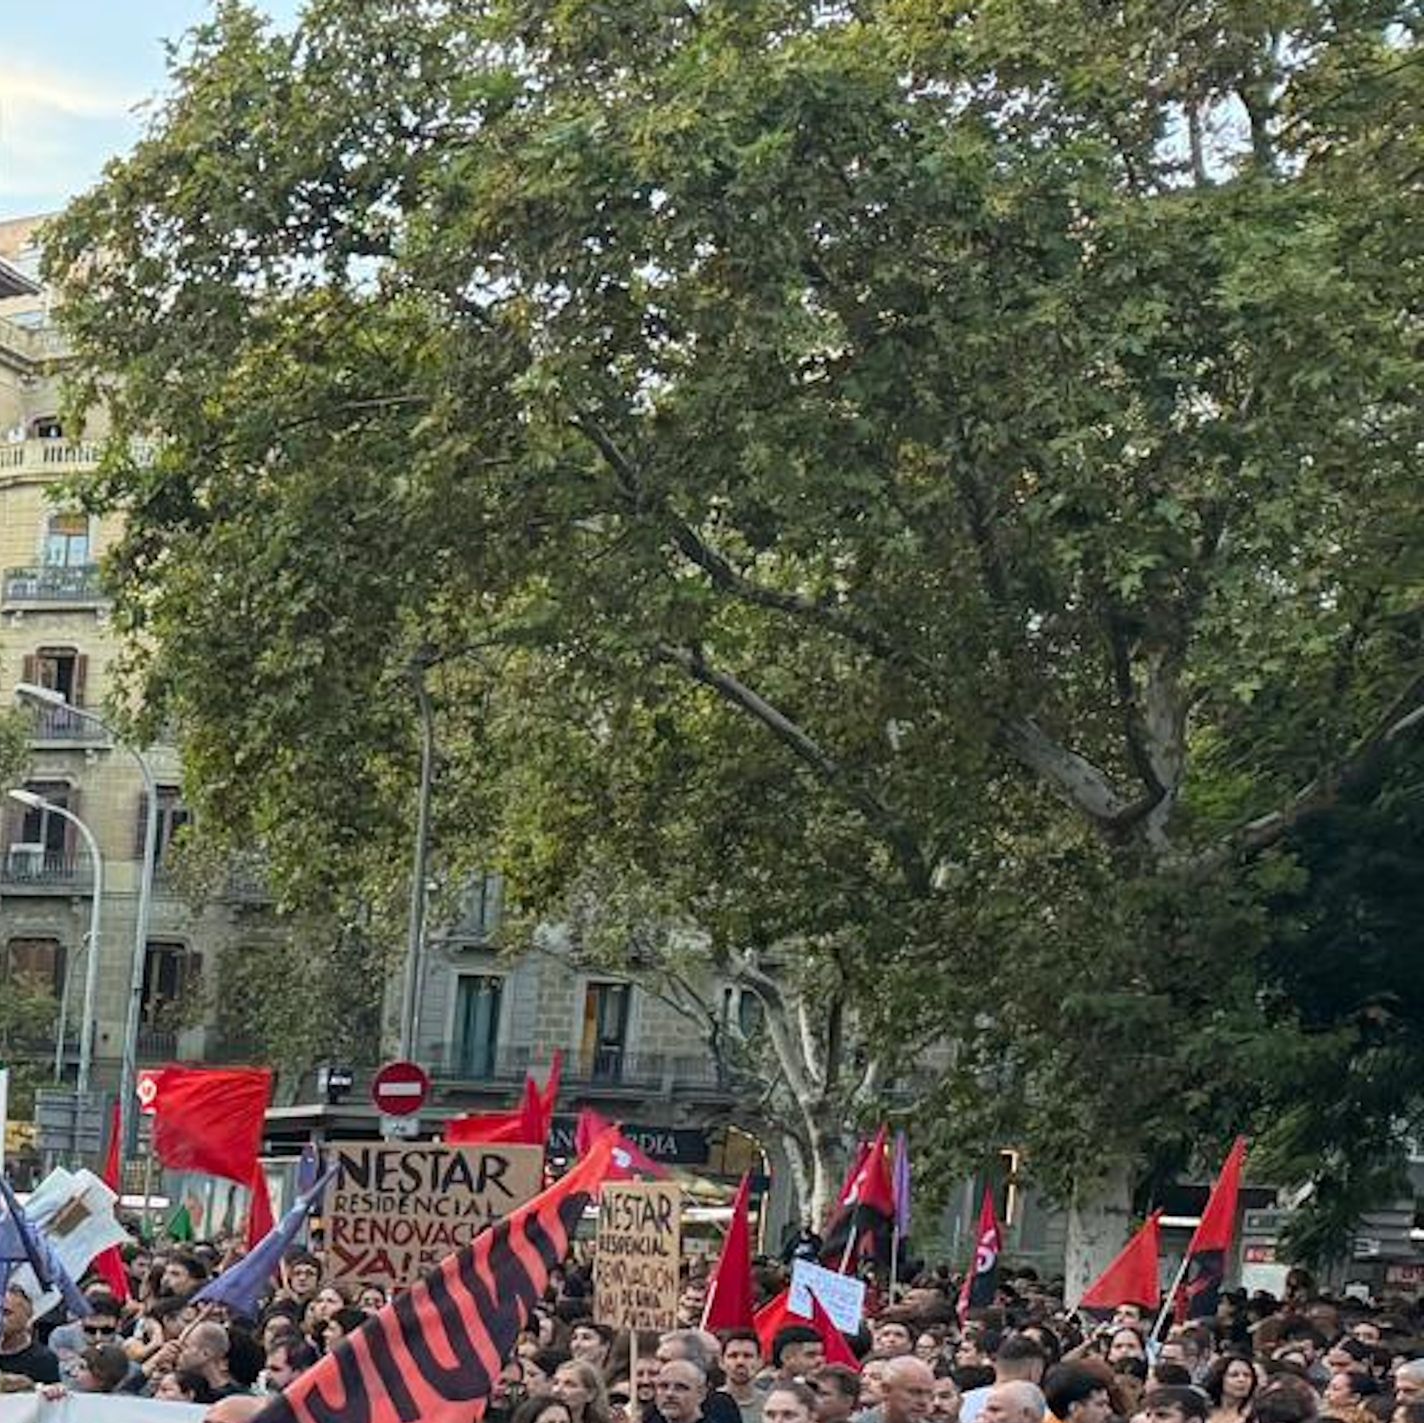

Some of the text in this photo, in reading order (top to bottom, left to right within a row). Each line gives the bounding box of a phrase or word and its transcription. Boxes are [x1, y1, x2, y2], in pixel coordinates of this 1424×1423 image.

[335, 1147, 514, 1198] NESTAR
[333, 1193, 504, 1220] RESIDENCIAL
[600, 1191, 673, 1235] NESTAR
[330, 1245, 413, 1283] YA!
